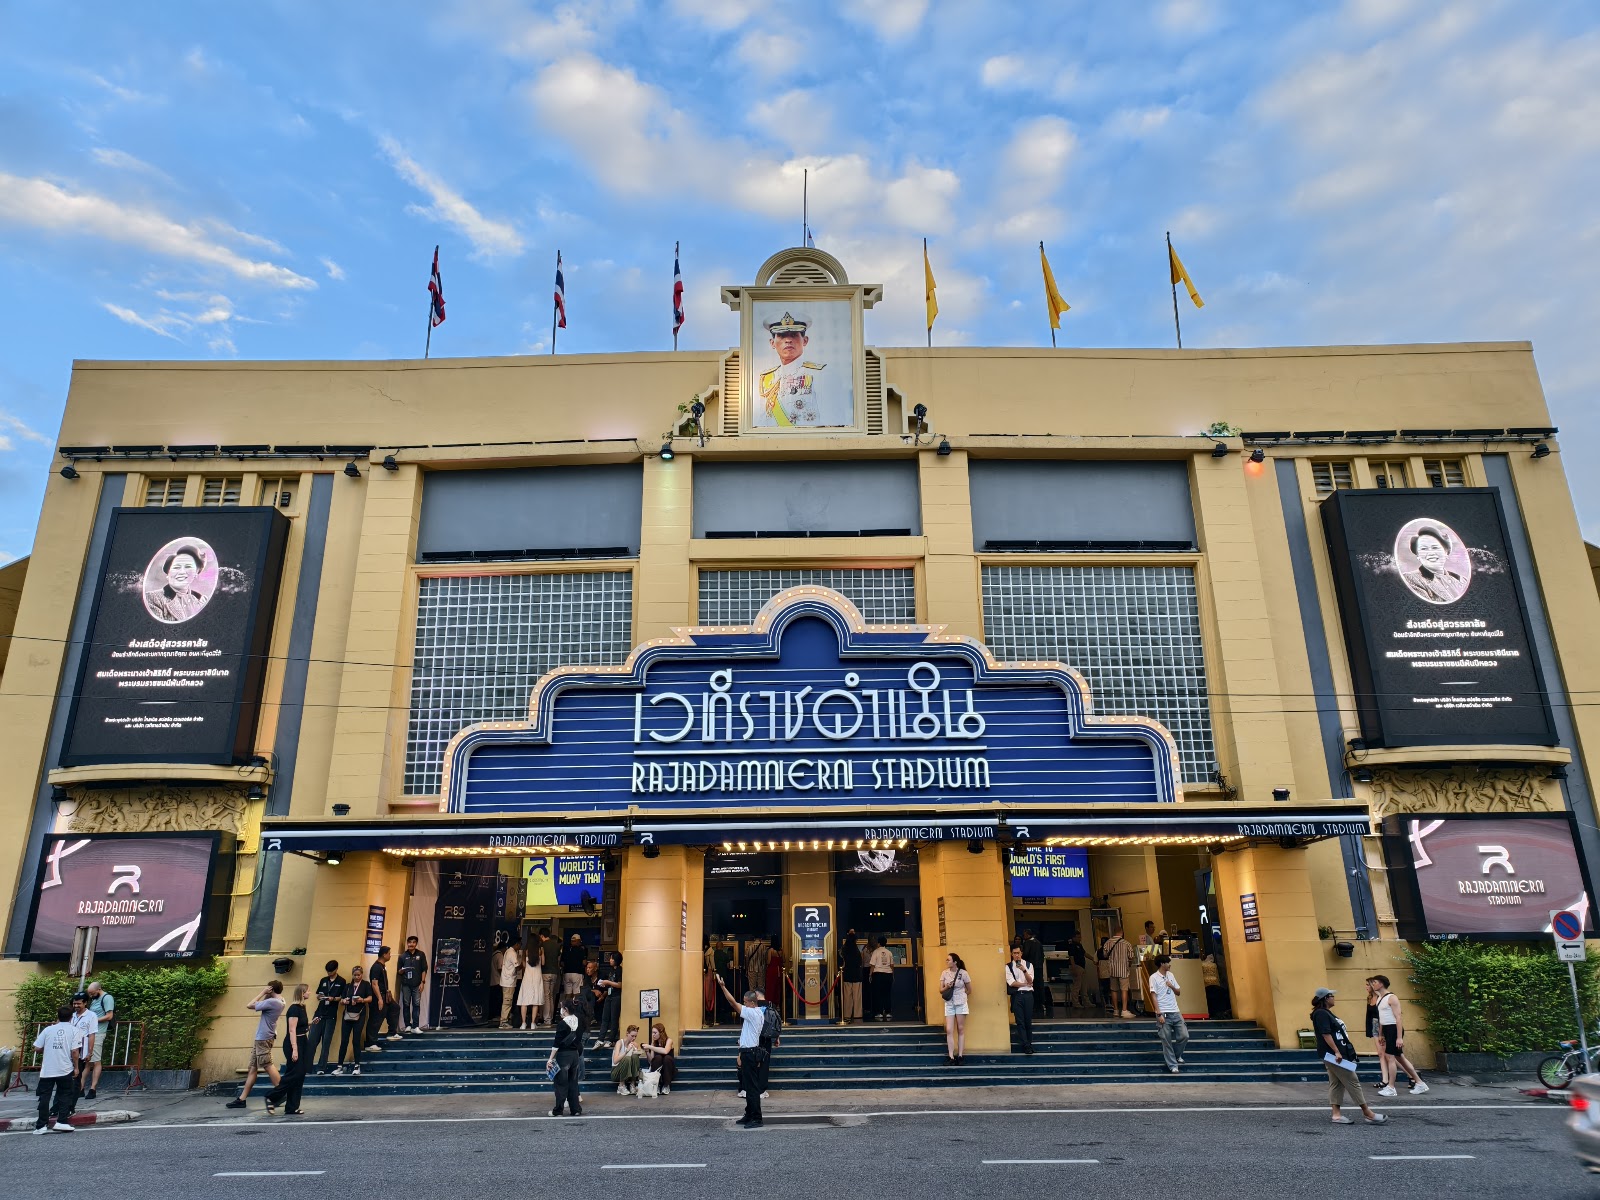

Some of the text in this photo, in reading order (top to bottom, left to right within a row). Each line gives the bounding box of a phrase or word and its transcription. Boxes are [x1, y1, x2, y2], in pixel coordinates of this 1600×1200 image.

[633, 661, 986, 744] เวทีราชดำเนิน
[631, 757, 991, 793] RAJADAMNERN STADIUM
[865, 826, 994, 839] RAJADAMNERN STADIUM
[1237, 823, 1366, 836] RAJADAMNERN STADIUM
[489, 833, 617, 847] RAJADAMNERN STADIUM
[1045, 854, 1066, 865] FIRST
[560, 861, 594, 872] WORLD'S
[1033, 866, 1050, 877] THAI
[1052, 867, 1085, 878] STADIUM
[559, 873, 581, 885] MUAY
[584, 872, 601, 884] THAI
[1458, 880, 1546, 894] RAJADAMNERN
[78, 899, 165, 914] RAJADAMNERN
[1488, 895, 1522, 905] STADIUM
[102, 915, 136, 925] STADIUM
